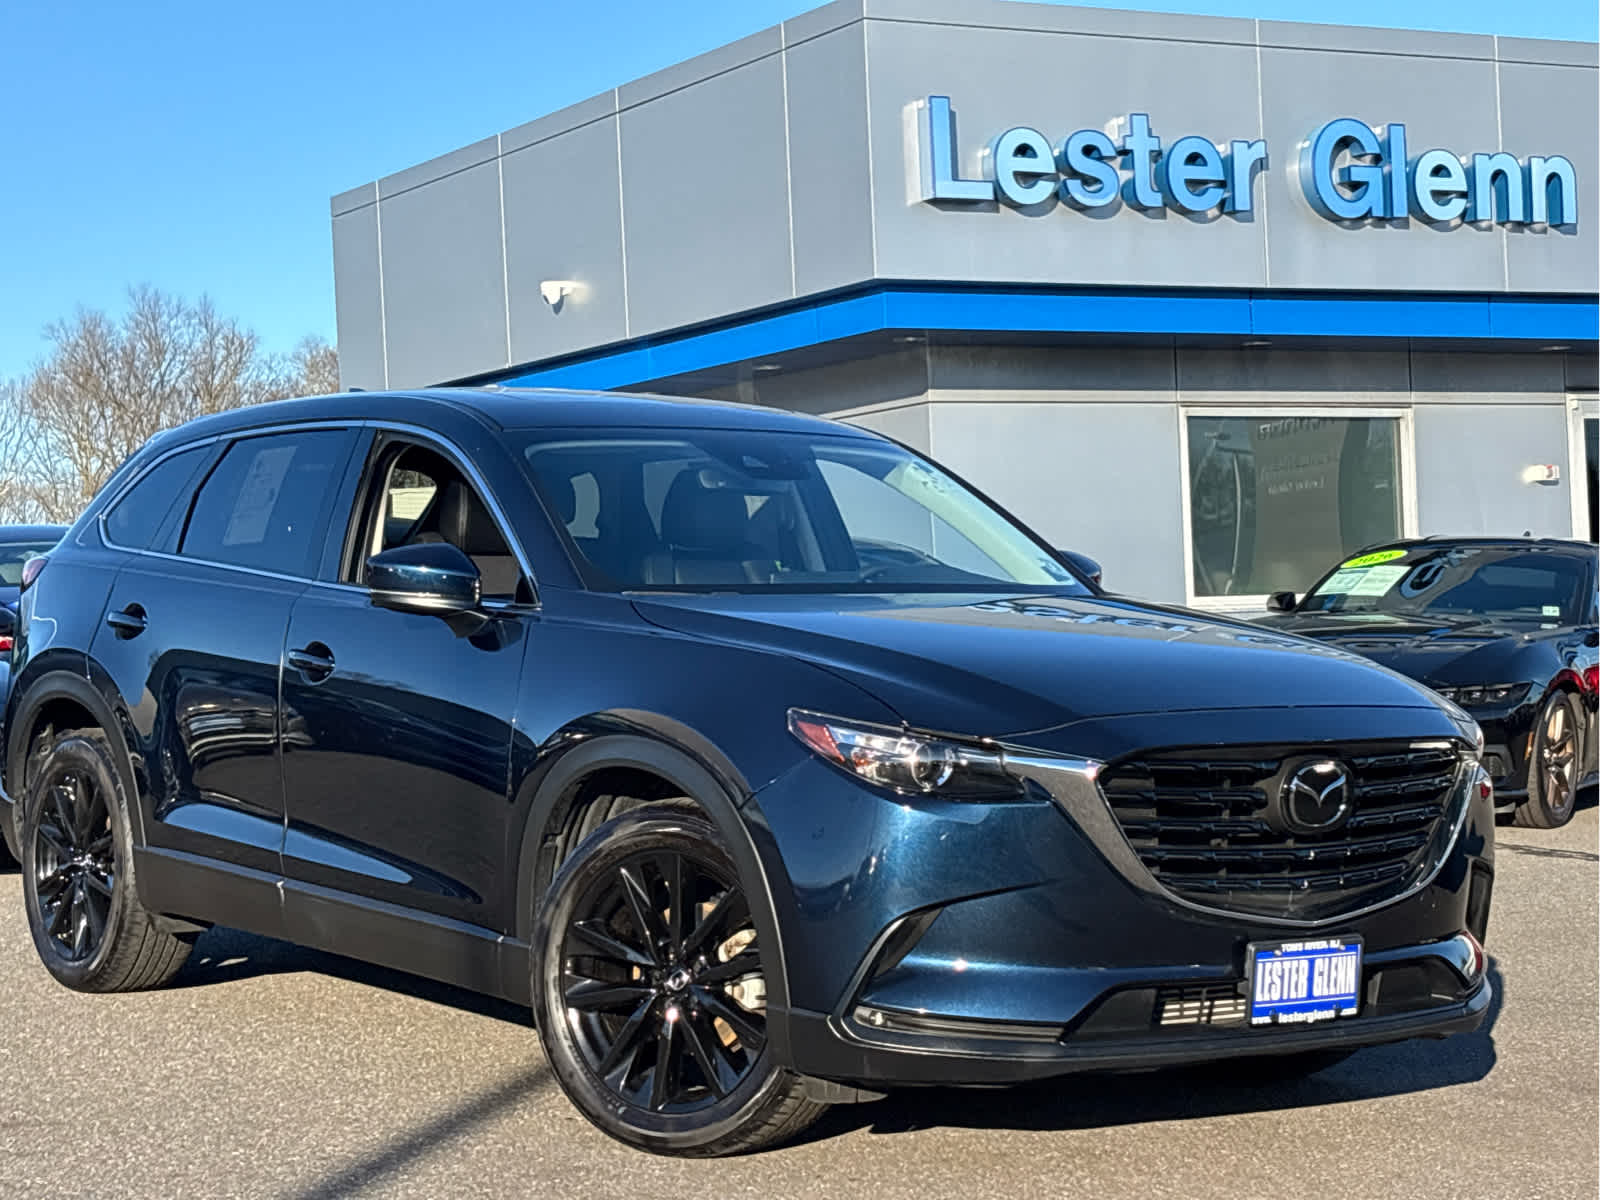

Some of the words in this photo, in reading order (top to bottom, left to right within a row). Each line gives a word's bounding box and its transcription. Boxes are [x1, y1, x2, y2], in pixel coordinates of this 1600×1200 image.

[910, 95, 1267, 213] Lester
[1306, 118, 1578, 225] Glenn
[1255, 959, 1308, 1001] LESTER
[1313, 955, 1356, 997] GLENN
